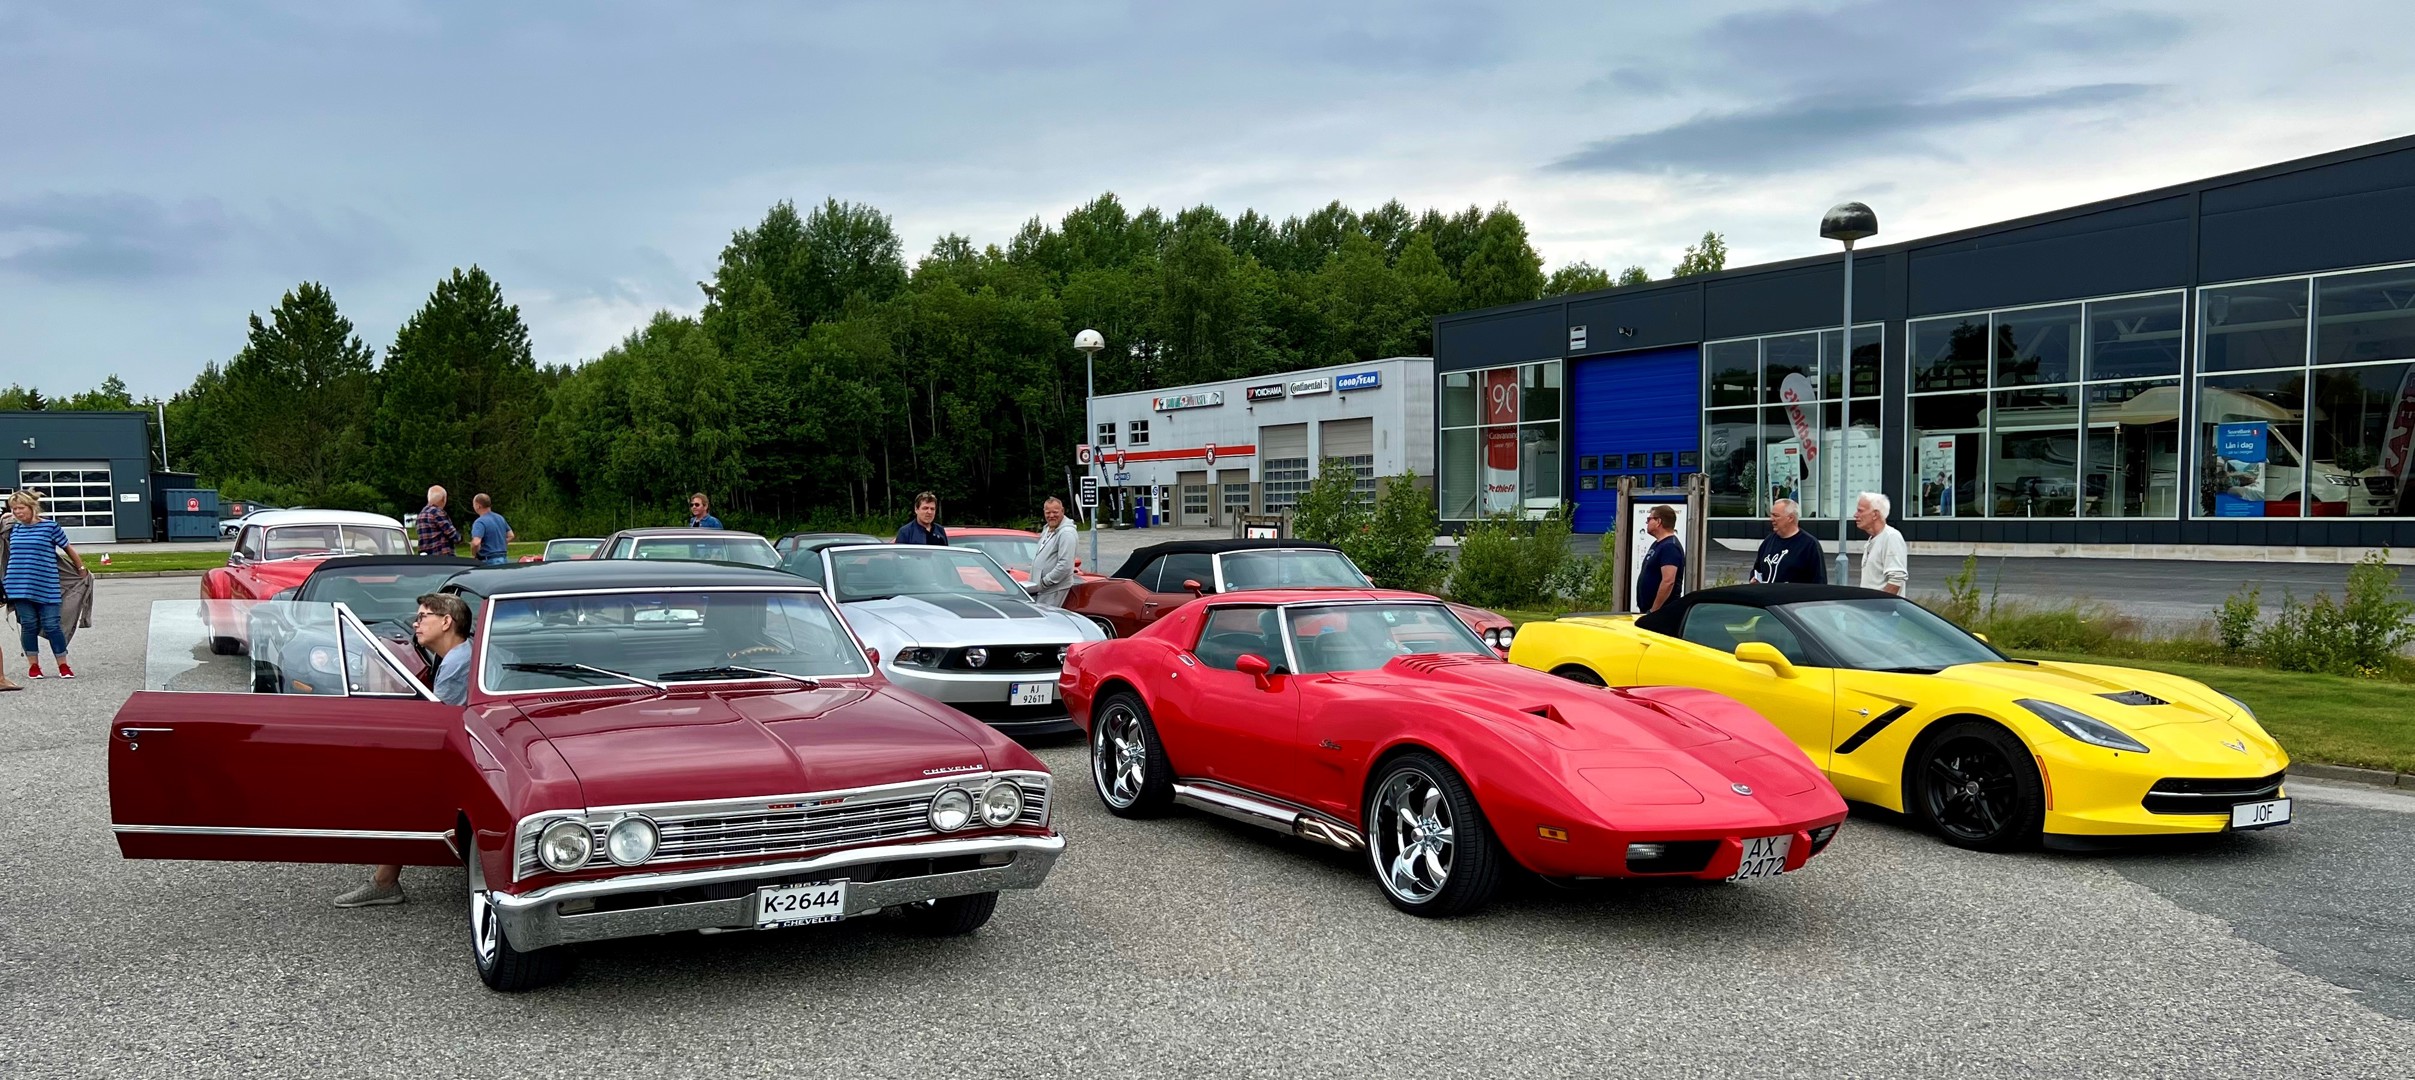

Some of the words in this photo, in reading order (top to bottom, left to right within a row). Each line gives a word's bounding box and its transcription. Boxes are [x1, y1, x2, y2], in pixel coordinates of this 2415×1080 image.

[1290, 379, 1323, 394] Continental
[1338, 375, 1376, 387] GOODYEAR
[1254, 386, 1283, 397] YOKOHAMA
[2240, 442, 2254, 450] dag
[1030, 685, 1040, 694] AJ
[1023, 694, 1045, 704] 92611
[922, 764, 984, 775] CHEVELLE
[2253, 804, 2274, 822] JOF
[1748, 836, 1778, 859] AX
[764, 890, 840, 914] K-2644
[783, 915, 838, 928] CHEVELLE
